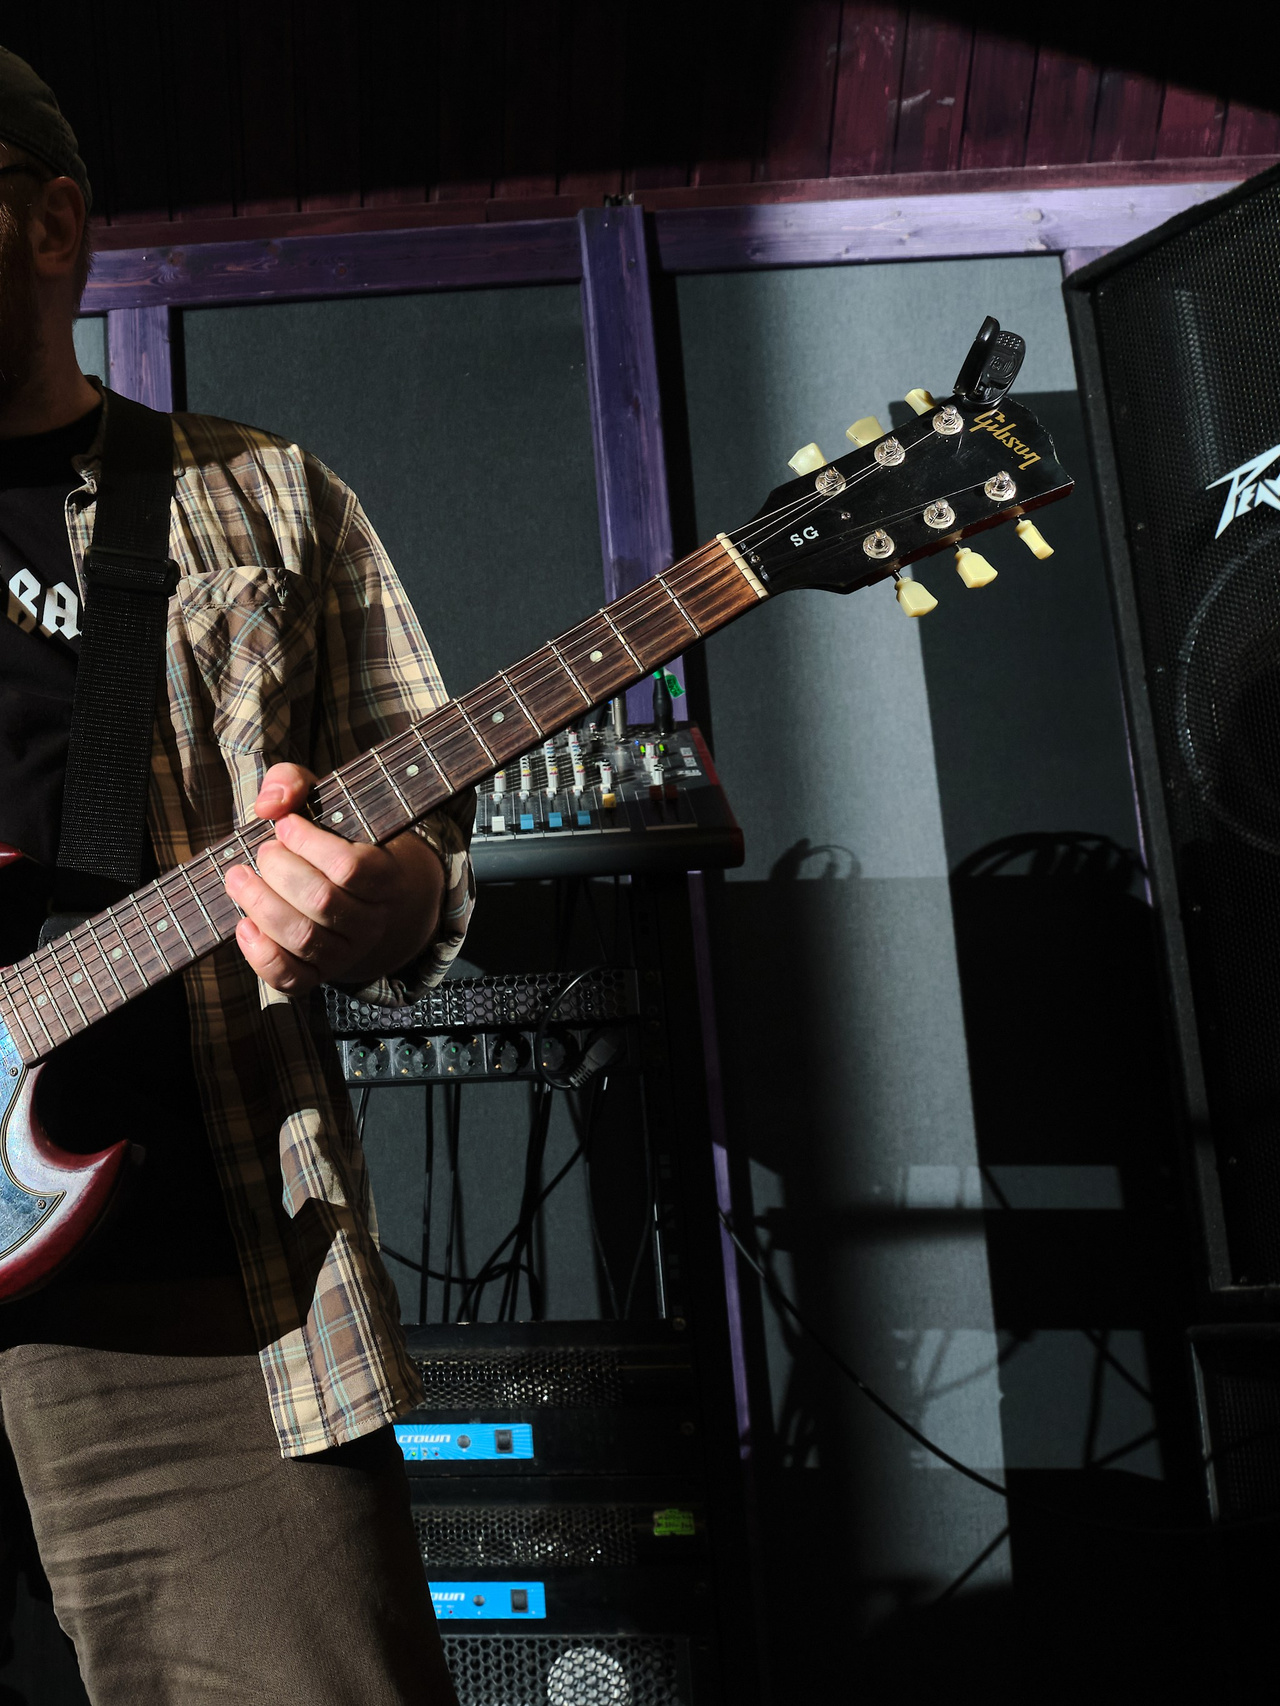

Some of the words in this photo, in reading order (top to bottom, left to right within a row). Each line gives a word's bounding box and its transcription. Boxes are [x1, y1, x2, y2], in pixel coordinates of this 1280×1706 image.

[969, 409, 1041, 471] Gibson
[790, 525, 820, 547] SG
[398, 1434, 451, 1444] crown
[430, 1592, 465, 1601] own
